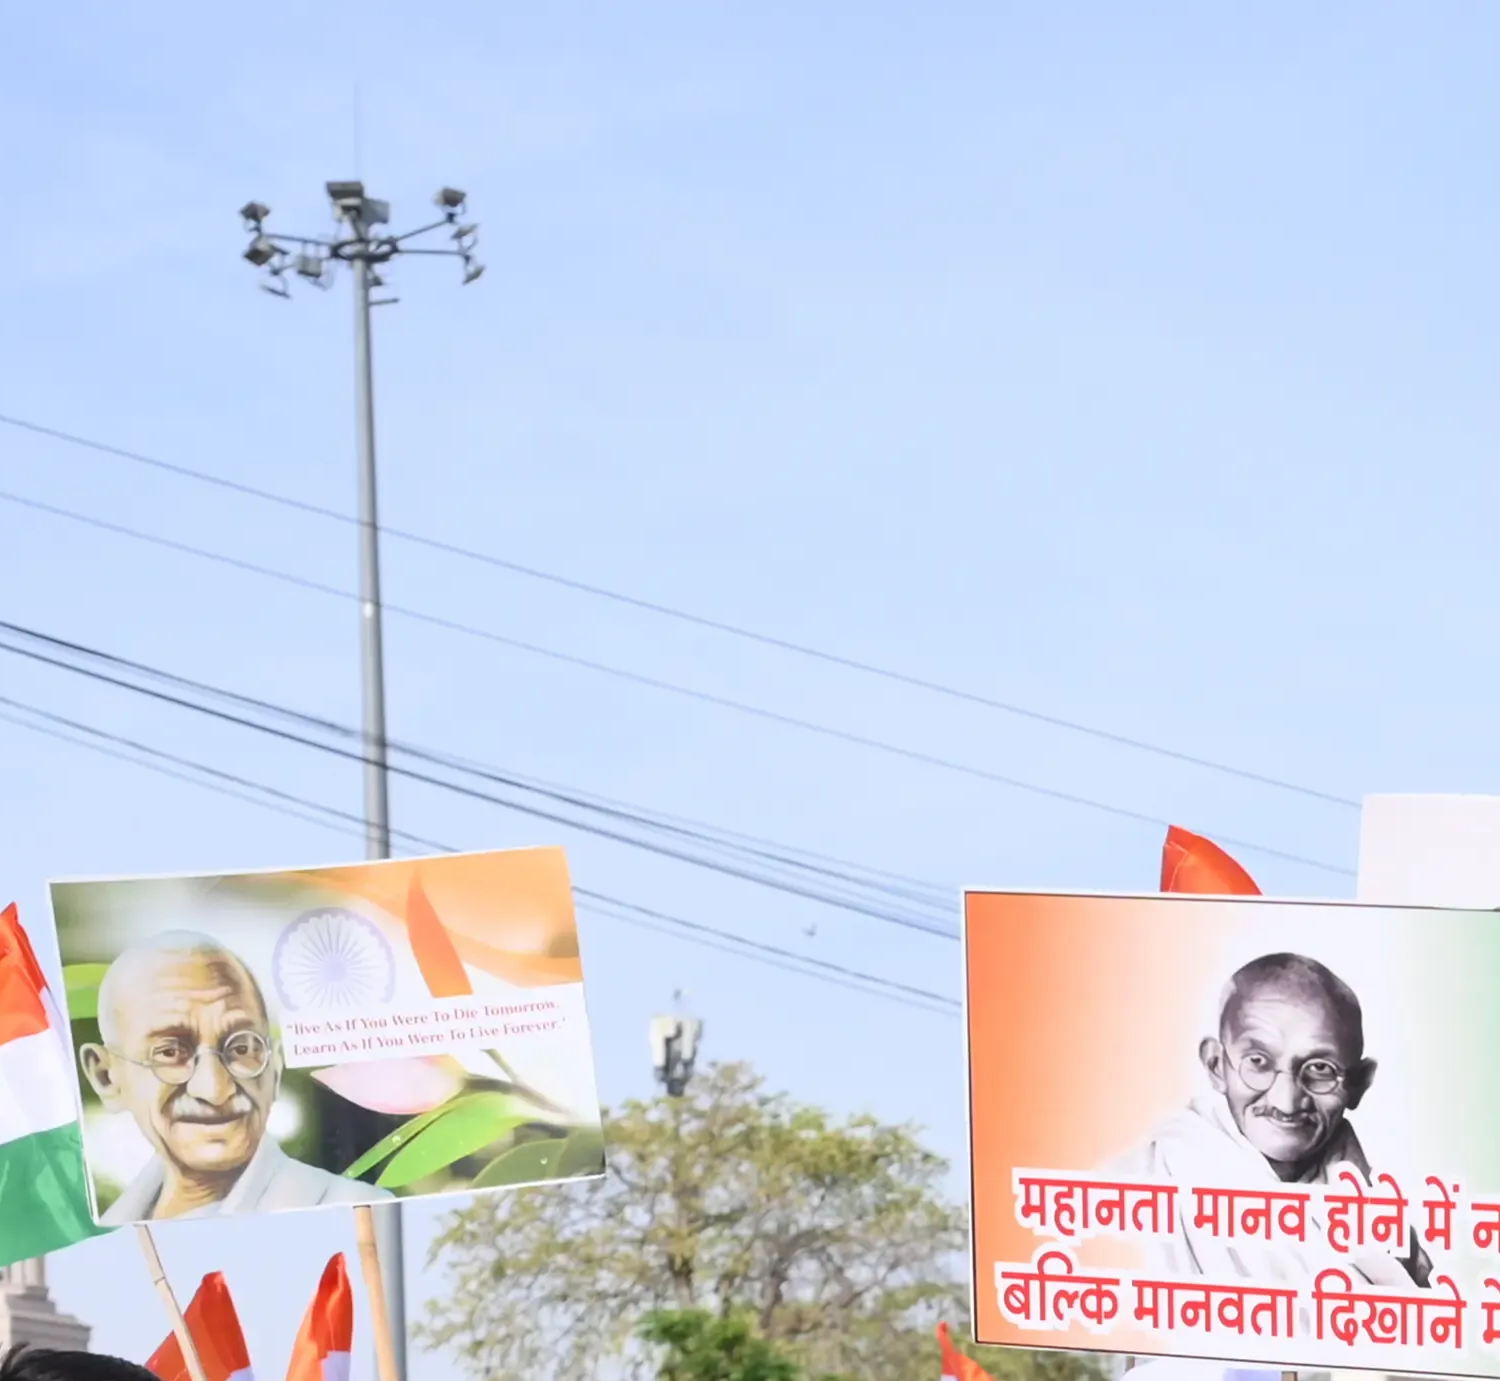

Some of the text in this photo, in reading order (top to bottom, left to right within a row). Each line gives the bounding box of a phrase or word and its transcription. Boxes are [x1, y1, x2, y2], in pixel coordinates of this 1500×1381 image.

[294, 1041, 336, 1056] Learn
[340, 1039, 358, 1053] As
[362, 1037, 373, 1051] If
[376, 1034, 404, 1049] You
[408, 1031, 444, 1045] Were
[449, 1028, 466, 1041] To
[469, 1024, 499, 1039] Live
[324, 1020, 342, 1034] As
[346, 1018, 357, 1032] If
[360, 1016, 387, 1030] You
[393, 1013, 428, 1027] Were
[433, 1010, 450, 1023] To
[454, 1007, 478, 1021] Die
[1021, 1179, 1177, 1235] महानता
[1194, 1188, 1309, 1240] मानव
[1325, 1172, 1407, 1252] होने
[1425, 1177, 1458, 1249] में
[1002, 1253, 1119, 1324] बल्कि
[1133, 1281, 1297, 1336] मानवता
[1313, 1270, 1466, 1347] दिखाने
